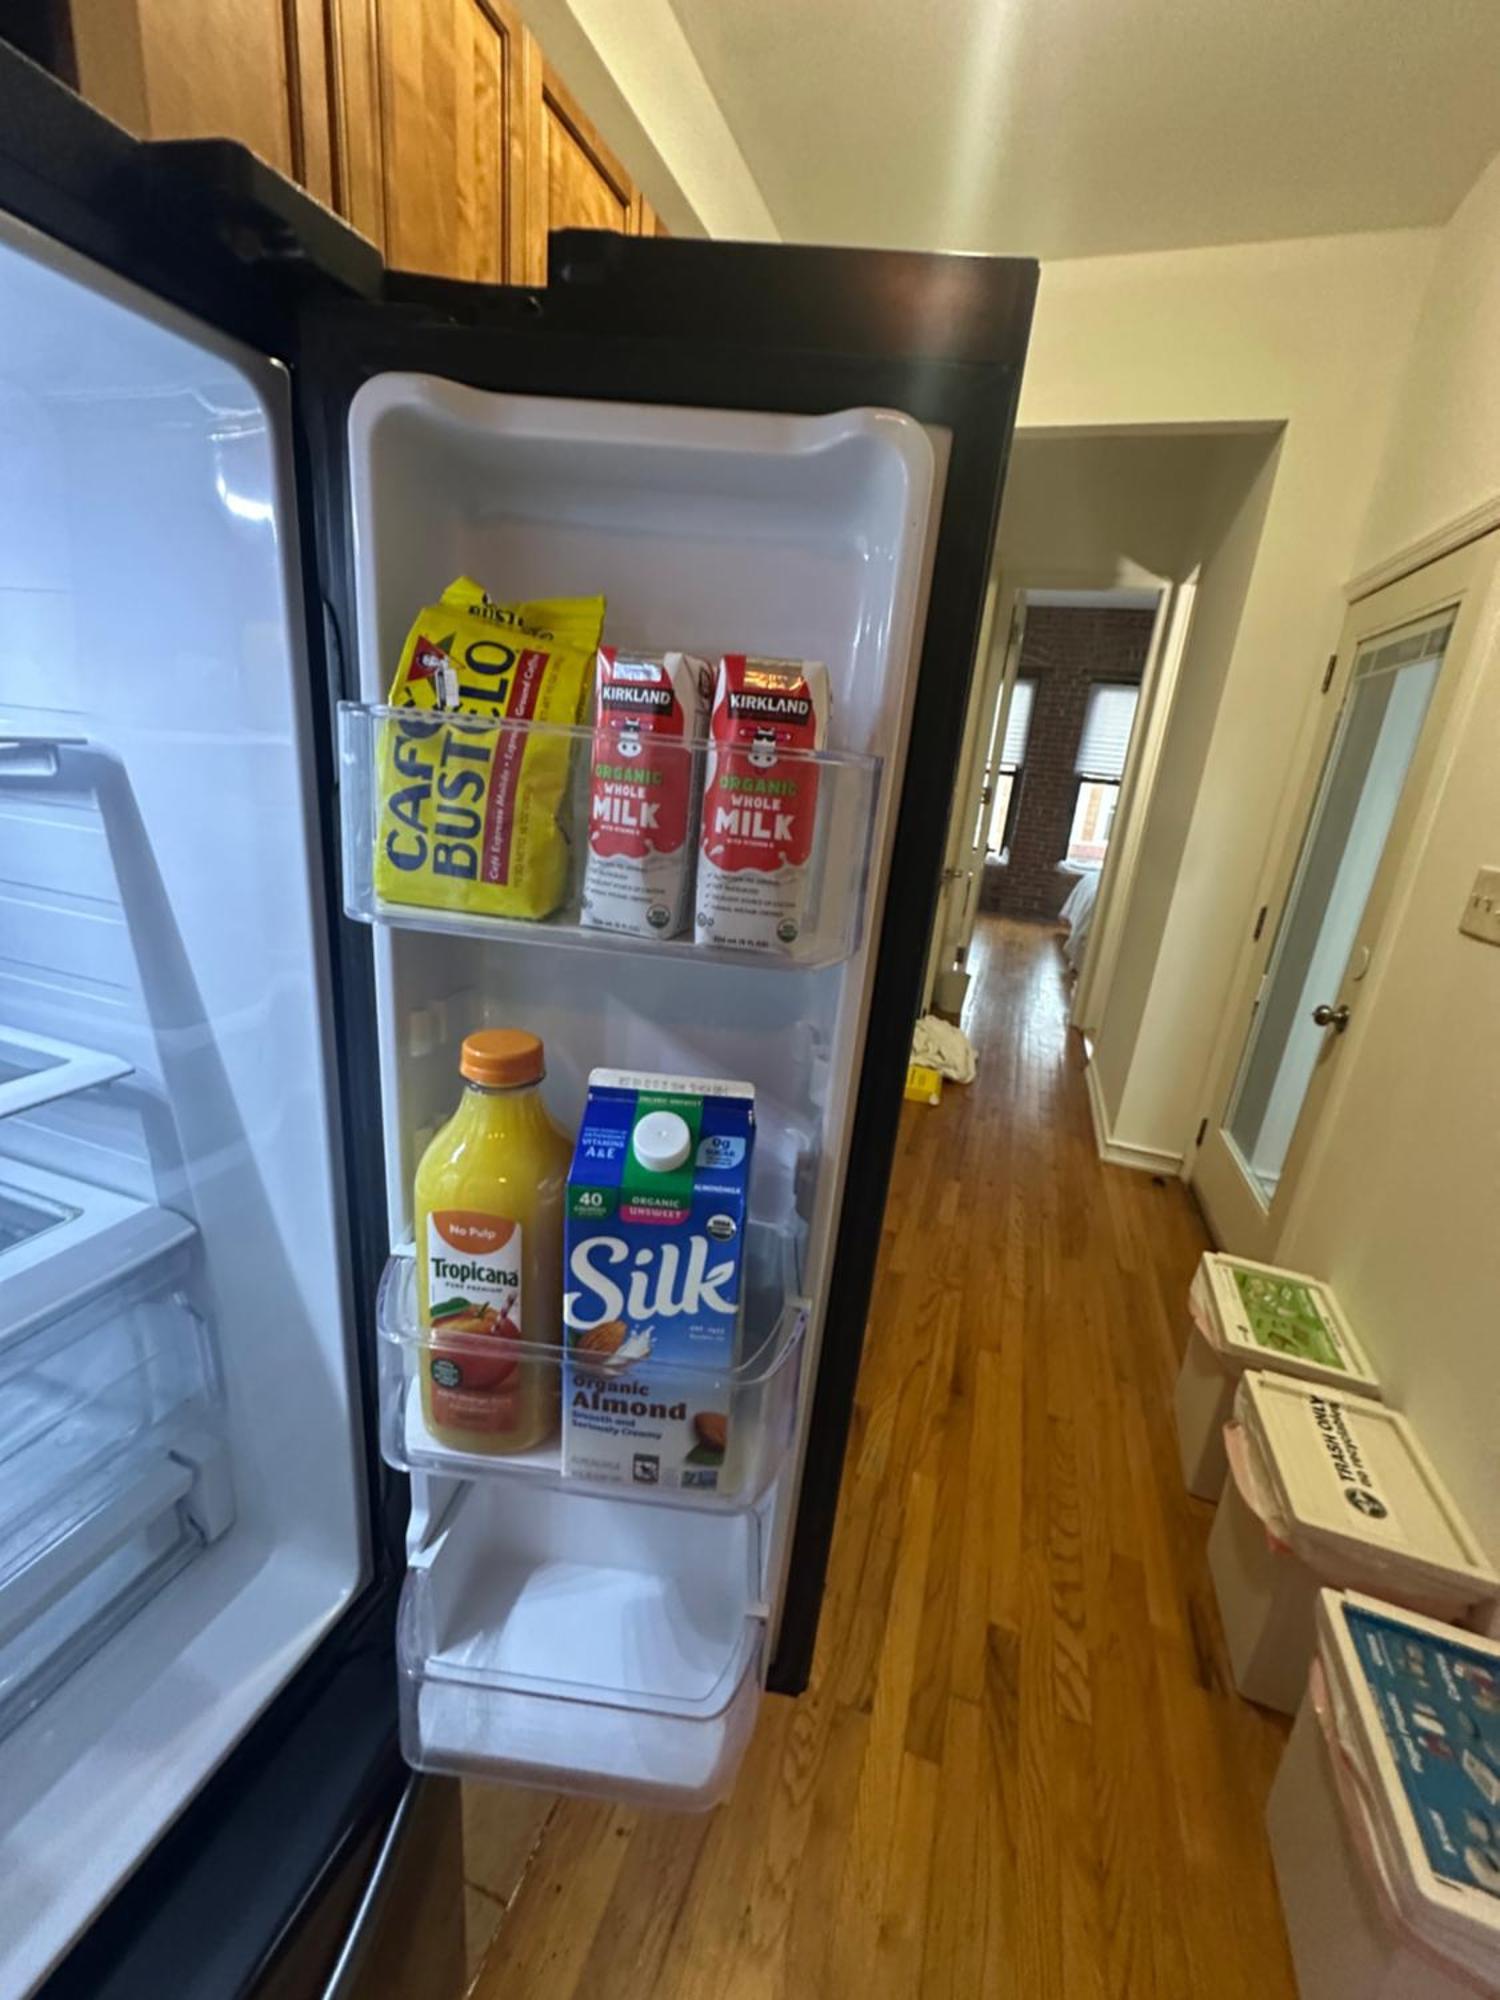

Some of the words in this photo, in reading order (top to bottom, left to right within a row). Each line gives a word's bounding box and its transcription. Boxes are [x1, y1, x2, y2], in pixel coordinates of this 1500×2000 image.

[602, 686, 672, 706] KIRKLAND
[730, 693, 809, 715] KIRKLAND
[433, 640, 515, 881] BUSTELO
[596, 766, 662, 785] ORGANIC
[719, 775, 798, 796] ORGANIC
[604, 783, 646, 798] WHOLE
[592, 796, 661, 829] MILK
[731, 794, 781, 811] WHOLE
[714, 806, 795, 841] MILK
[712, 1137, 731, 1150] 0g
[579, 1191, 603, 1206] 40
[631, 1196, 681, 1208] ORGANIC
[629, 1206, 682, 1219] UNSWEET
[448, 1223, 467, 1237] No
[469, 1226, 497, 1240] Pulp
[431, 1257, 518, 1287] Tropicana
[445, 1281, 465, 1289] PURE
[466, 1284, 503, 1293] PREMIUM
[564, 1235, 739, 1330] Silk
[572, 1391, 687, 1421] Almond
[1309, 1394, 1333, 1431] ONLY
[1322, 1433, 1356, 1482] TRASH
